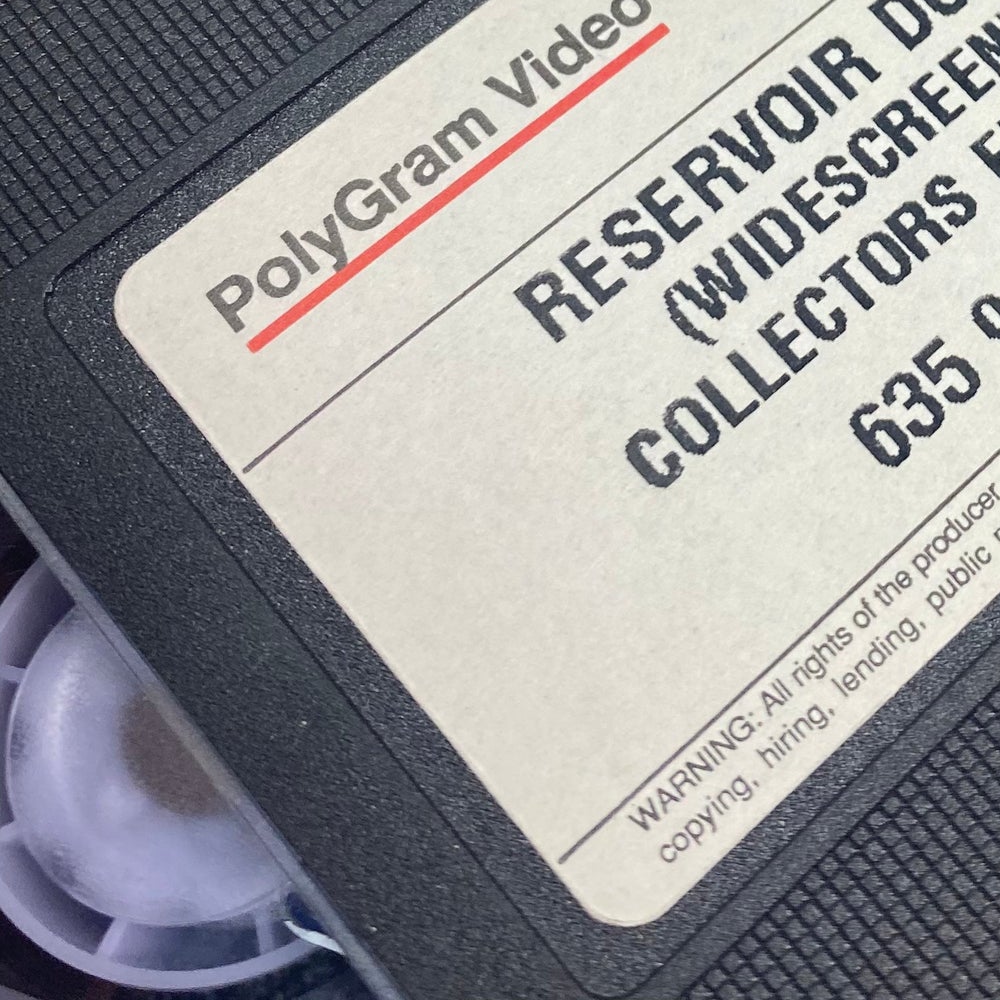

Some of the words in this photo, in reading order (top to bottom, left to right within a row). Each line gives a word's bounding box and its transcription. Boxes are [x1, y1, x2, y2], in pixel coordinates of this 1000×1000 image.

[206, 108, 498, 333] PolyGram
[513, 36, 882, 343] RESERVOIR
[624, 174, 977, 489] COLLECTORS
[849, 336, 981, 468] 635
[628, 712, 761, 831] WARNING:
[761, 679, 793, 716] All
[792, 627, 853, 686] rights
[853, 598, 877, 628] of
[874, 571, 912, 606] the
[912, 483, 1000, 578] producer
[660, 776, 759, 863] copying,
[756, 705, 834, 768] hiring,
[831, 618, 926, 697] lending,
[926, 546, 992, 616] public
